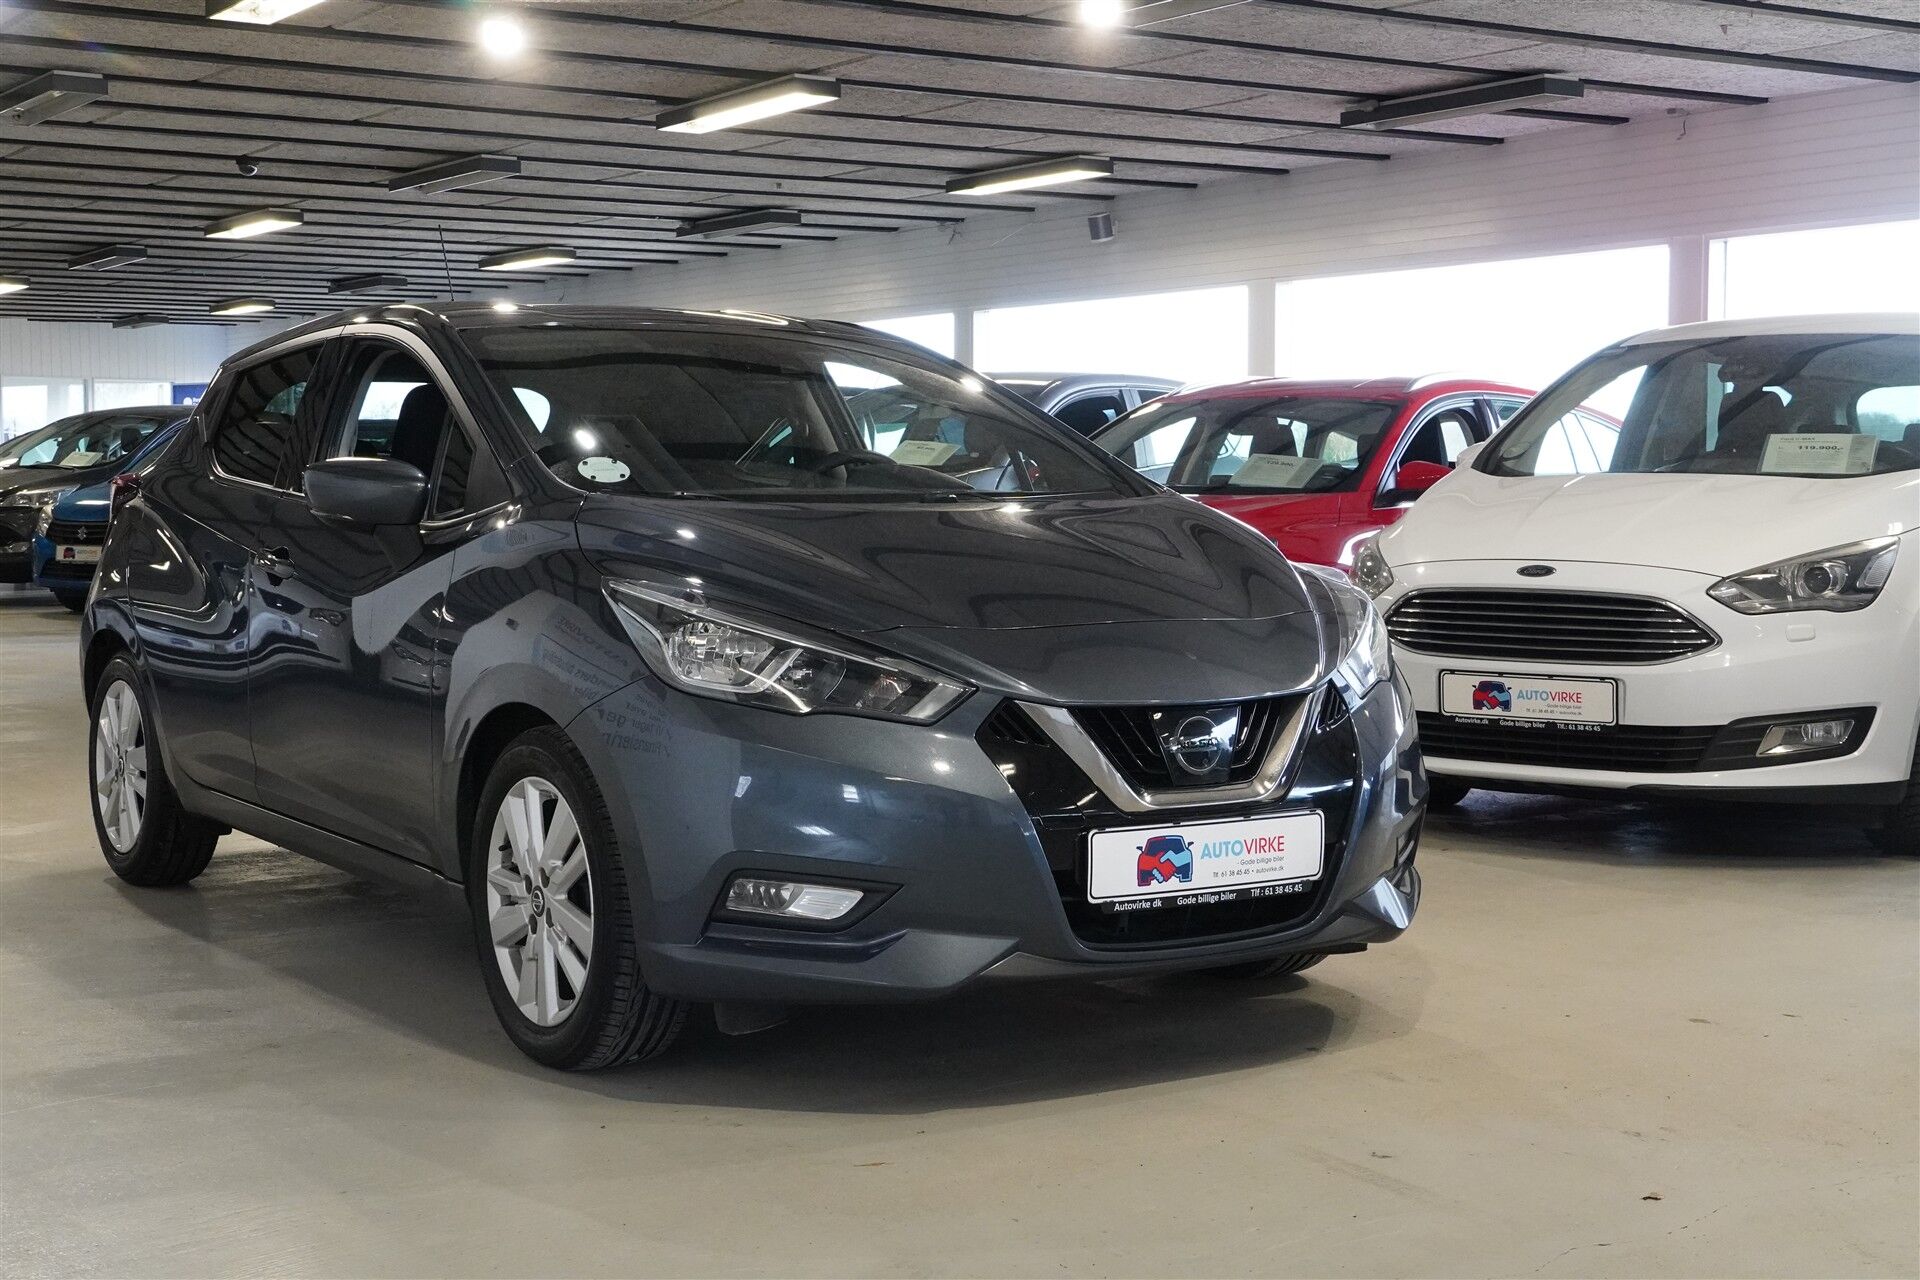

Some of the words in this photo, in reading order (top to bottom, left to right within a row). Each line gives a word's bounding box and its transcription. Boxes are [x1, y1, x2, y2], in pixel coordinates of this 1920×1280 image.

[1517, 689, 1582, 703] AUTOVIRKE
[1455, 717, 1489, 725] Autovirke.dk
[1500, 719, 1514, 727] Gode
[1515, 720, 1532, 728] billige
[1201, 836, 1285, 859] AUTOVIRKE
[1265, 887, 1273, 896] 61
[1275, 885, 1283, 894] 38
[1284, 884, 1293, 893] 45
[1294, 883, 1302, 892] 45
[1177, 895, 1197, 905] Gode
[1198, 893, 1220, 904] billige
[1220, 892, 1237, 901] biler
